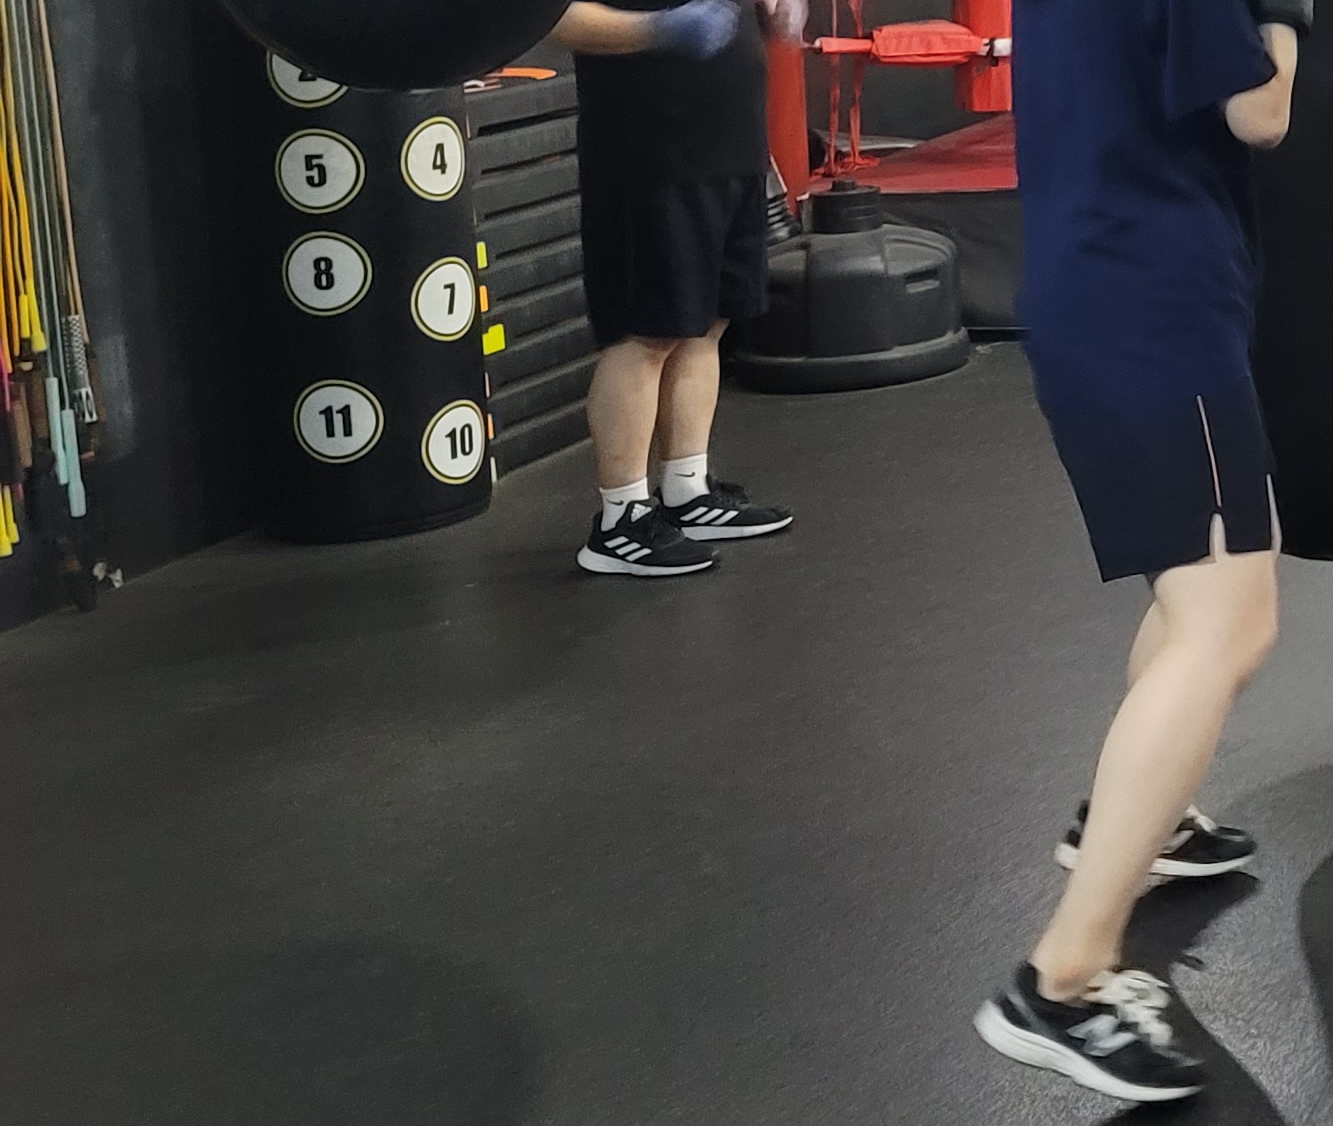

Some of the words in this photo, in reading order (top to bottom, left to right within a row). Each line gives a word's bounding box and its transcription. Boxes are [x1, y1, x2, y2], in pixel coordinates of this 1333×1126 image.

[304, 153, 327, 188] 5
[432, 142, 447, 175] 4
[313, 256, 335, 291] 8
[443, 282, 456, 316] 7
[318, 403, 354, 439] 11
[444, 422, 474, 460] 10
